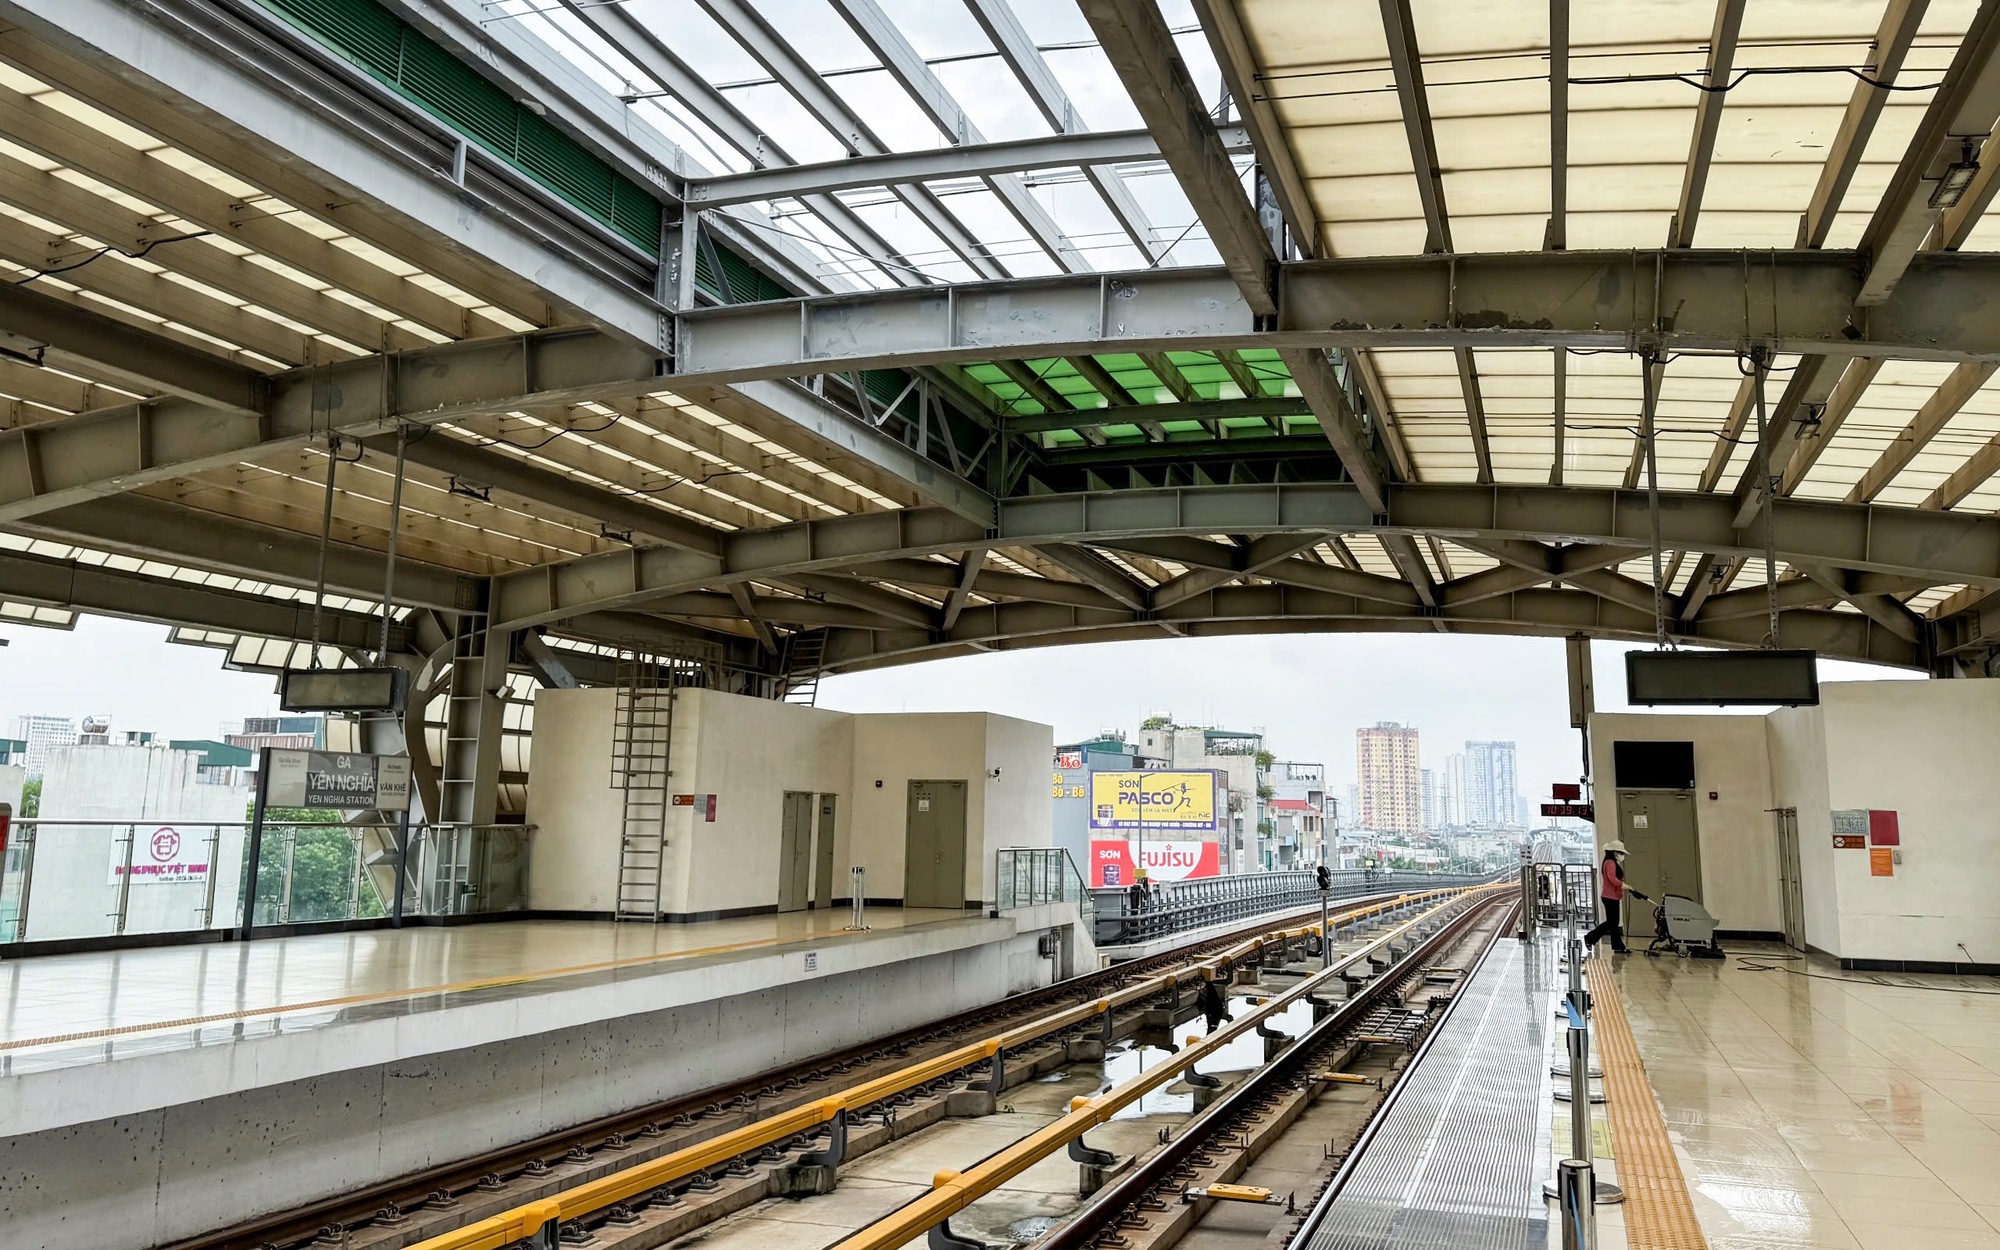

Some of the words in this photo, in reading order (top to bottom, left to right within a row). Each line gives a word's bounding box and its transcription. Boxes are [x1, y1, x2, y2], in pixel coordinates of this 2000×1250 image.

[337, 756, 351, 769] GA
[310, 770, 335, 791] YÊN
[336, 772, 375, 792] NGHĨA
[1118, 779, 1139, 788] SƠN
[393, 782, 407, 793] KHÊ
[308, 794, 323, 804] YEN
[324, 795, 346, 805] NGHIA
[346, 796, 375, 806] STATION
[1118, 792, 1174, 805] PASCO
[1546, 806, 1588, 815] 10:39:13
[1099, 850, 1121, 859] SƠN
